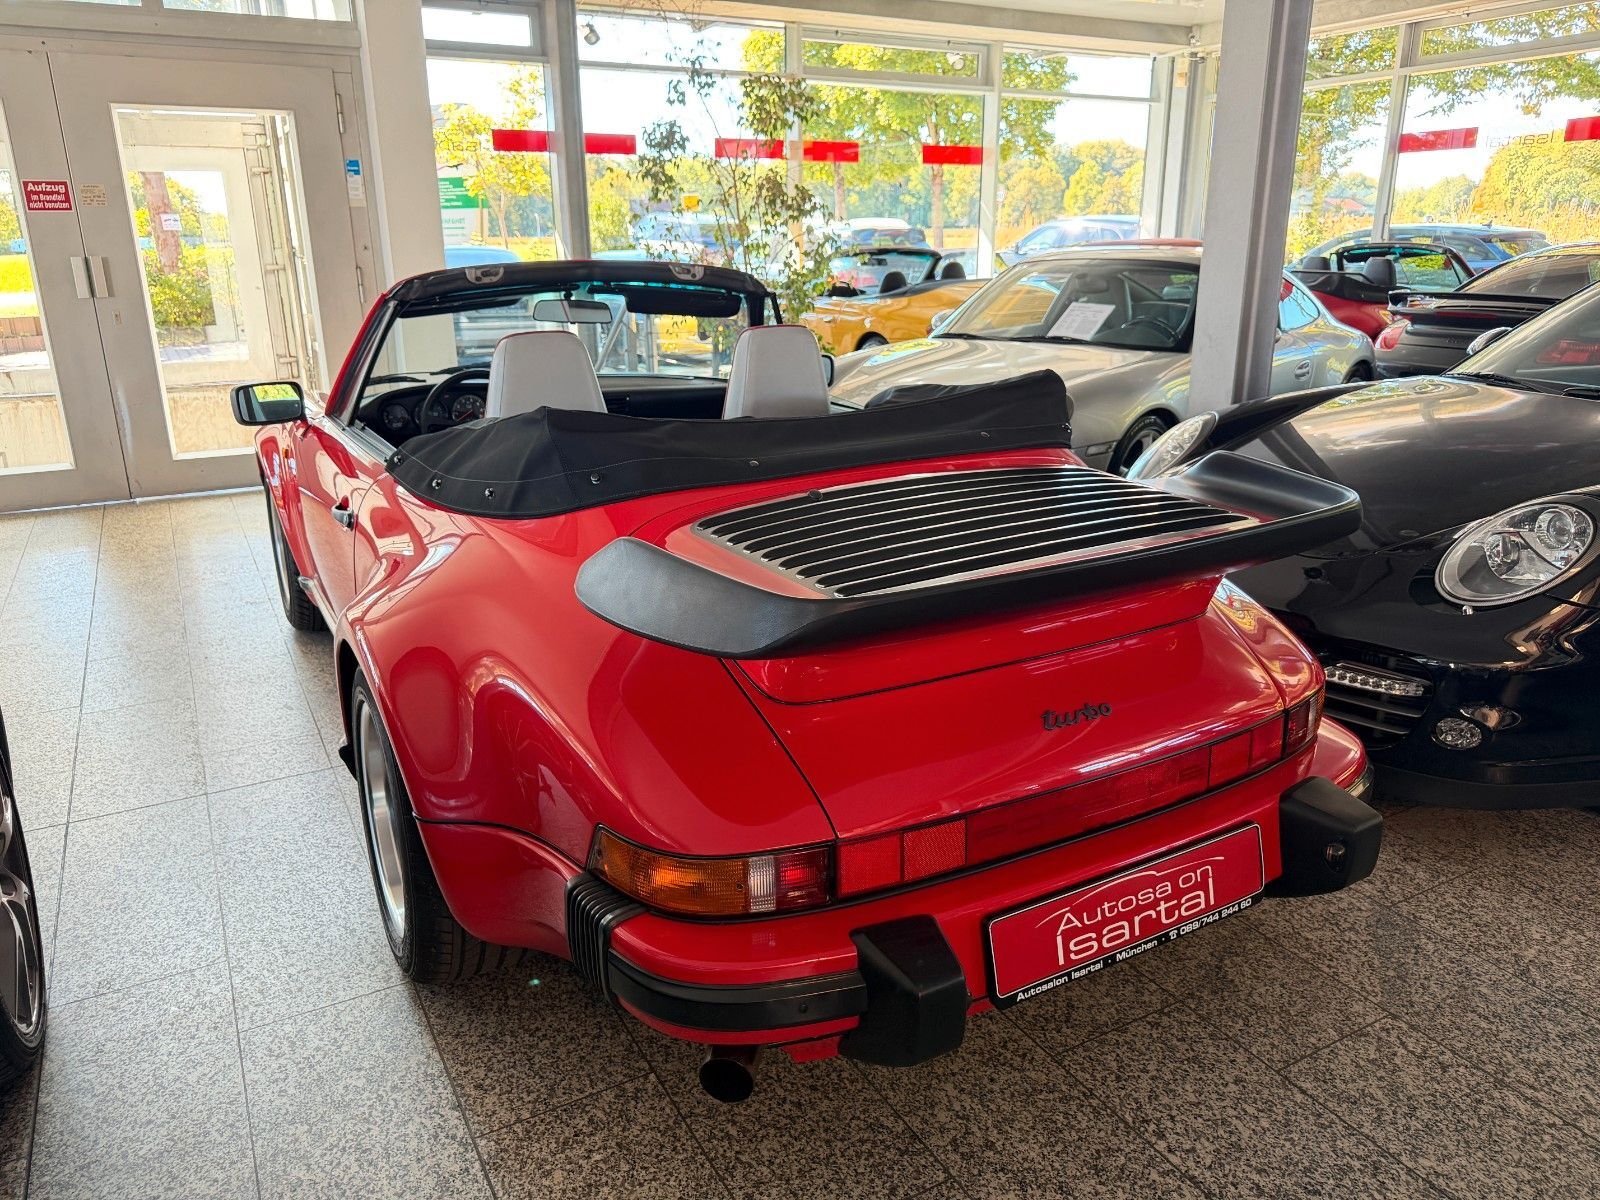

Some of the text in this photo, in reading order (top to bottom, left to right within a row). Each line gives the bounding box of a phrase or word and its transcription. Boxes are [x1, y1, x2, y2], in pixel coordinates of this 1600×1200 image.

[27, 182, 66, 193] Aufzug
[31, 193, 65, 201] im Brandfall
[29, 201, 70, 209] nicht benutzen
[1040, 703, 1113, 730] turbo
[1056, 877, 1215, 966] Isartal
[1016, 898, 1252, 1002] Autosalon Isartal München 089/744 244 60
